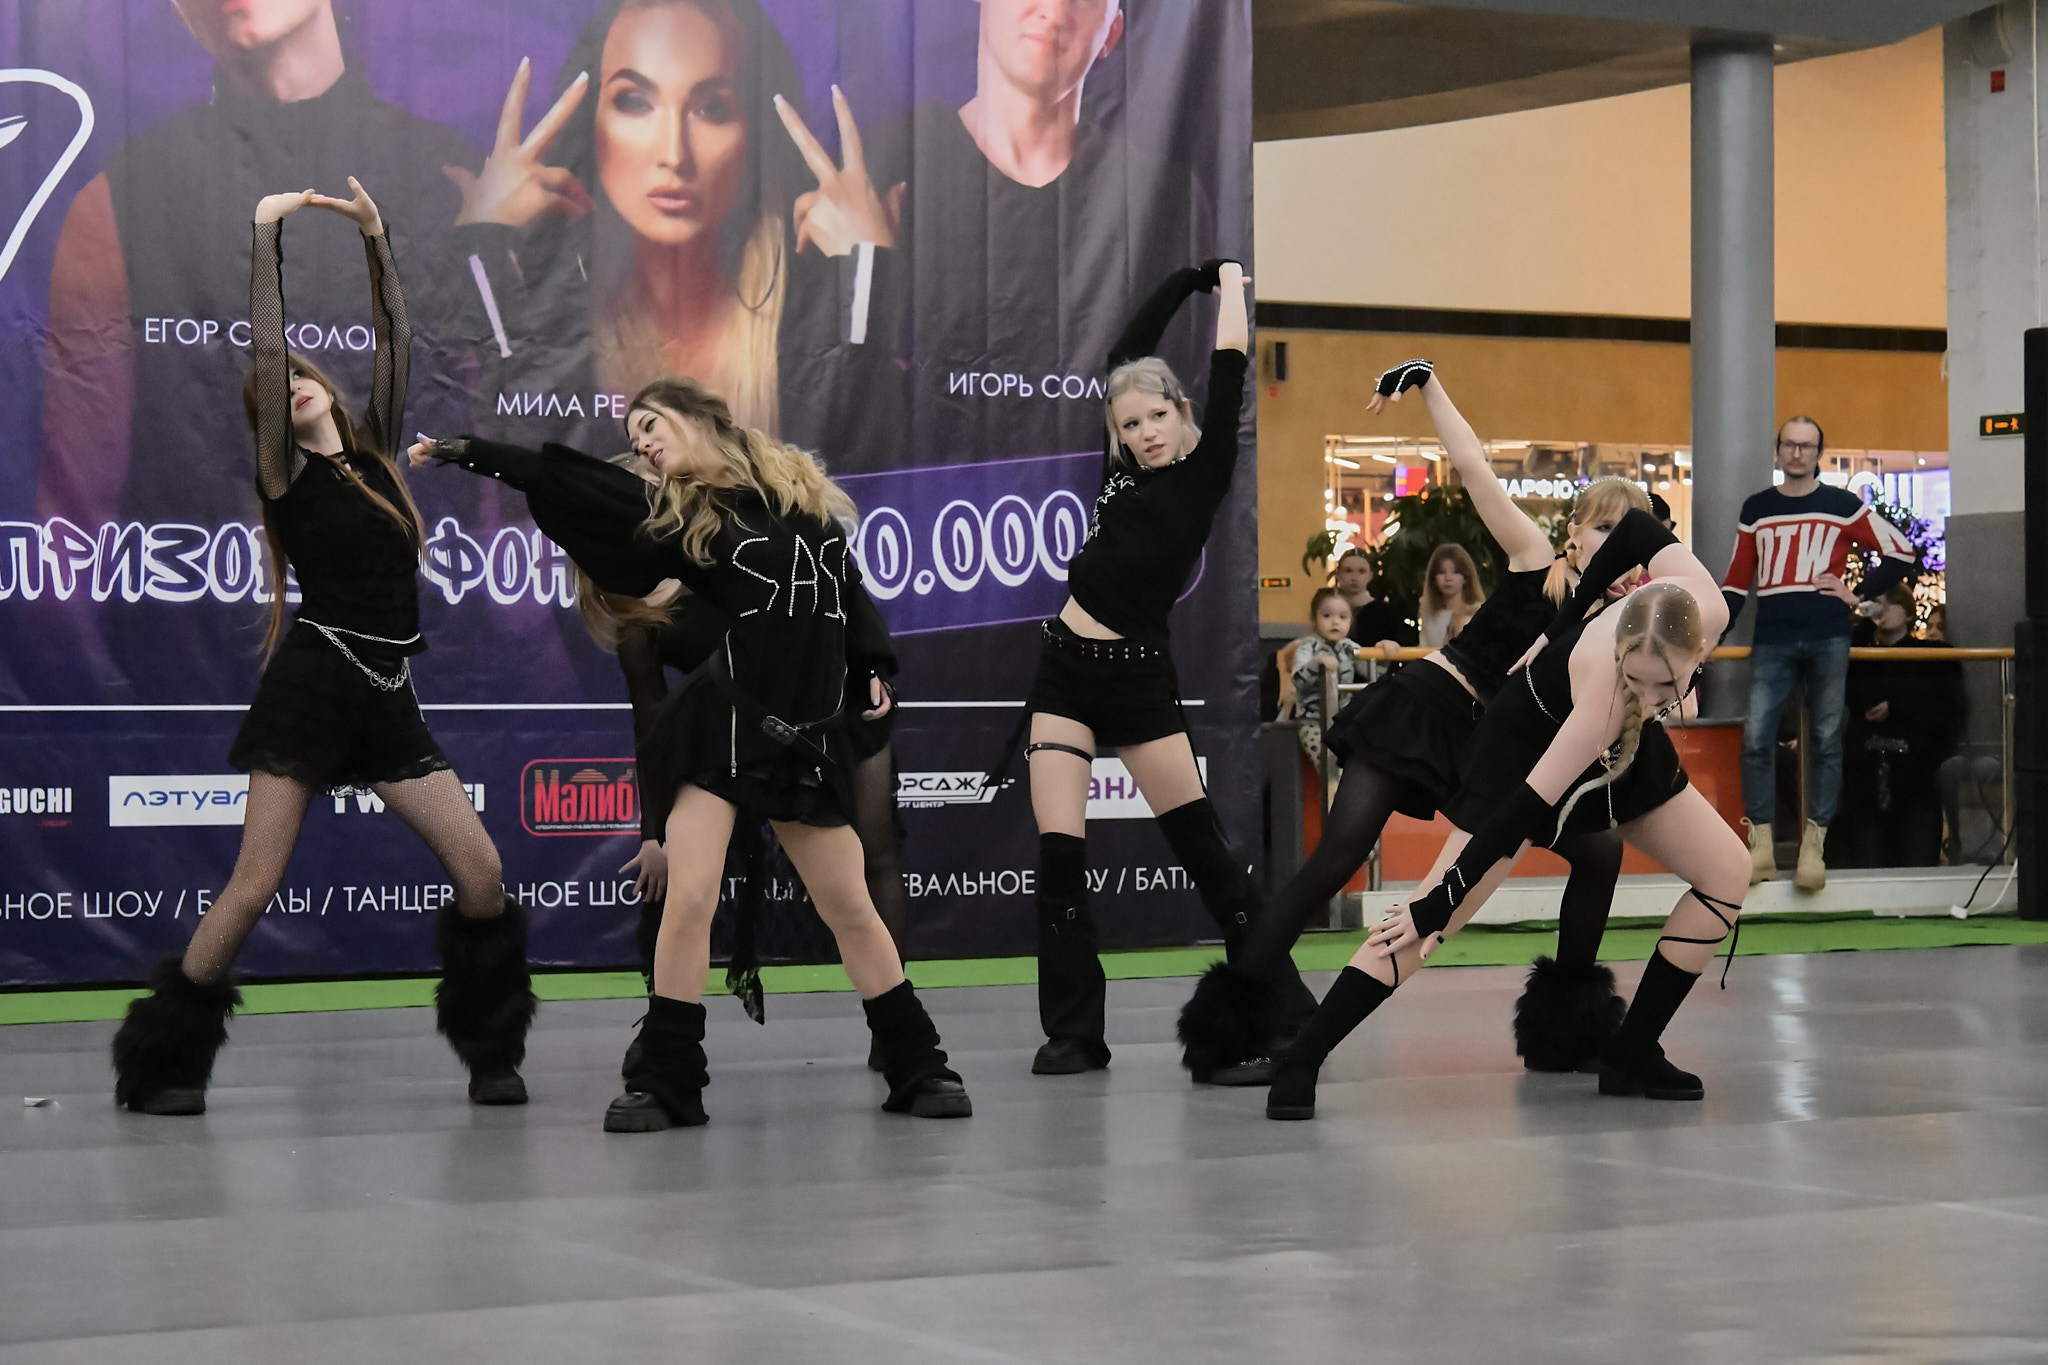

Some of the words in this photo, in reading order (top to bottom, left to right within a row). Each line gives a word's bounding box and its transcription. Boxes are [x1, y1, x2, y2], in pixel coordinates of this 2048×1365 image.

[145, 318, 219, 345] ЕГОР
[229, 320, 377, 351] СКОЛО
[949, 372, 1034, 397] ИГОРЬ
[1041, 375, 1107, 400] СОЛ
[496, 392, 585, 417] МИЛА
[0, 892, 73, 920] НОЕ
[83, 889, 163, 918] ШОУ
